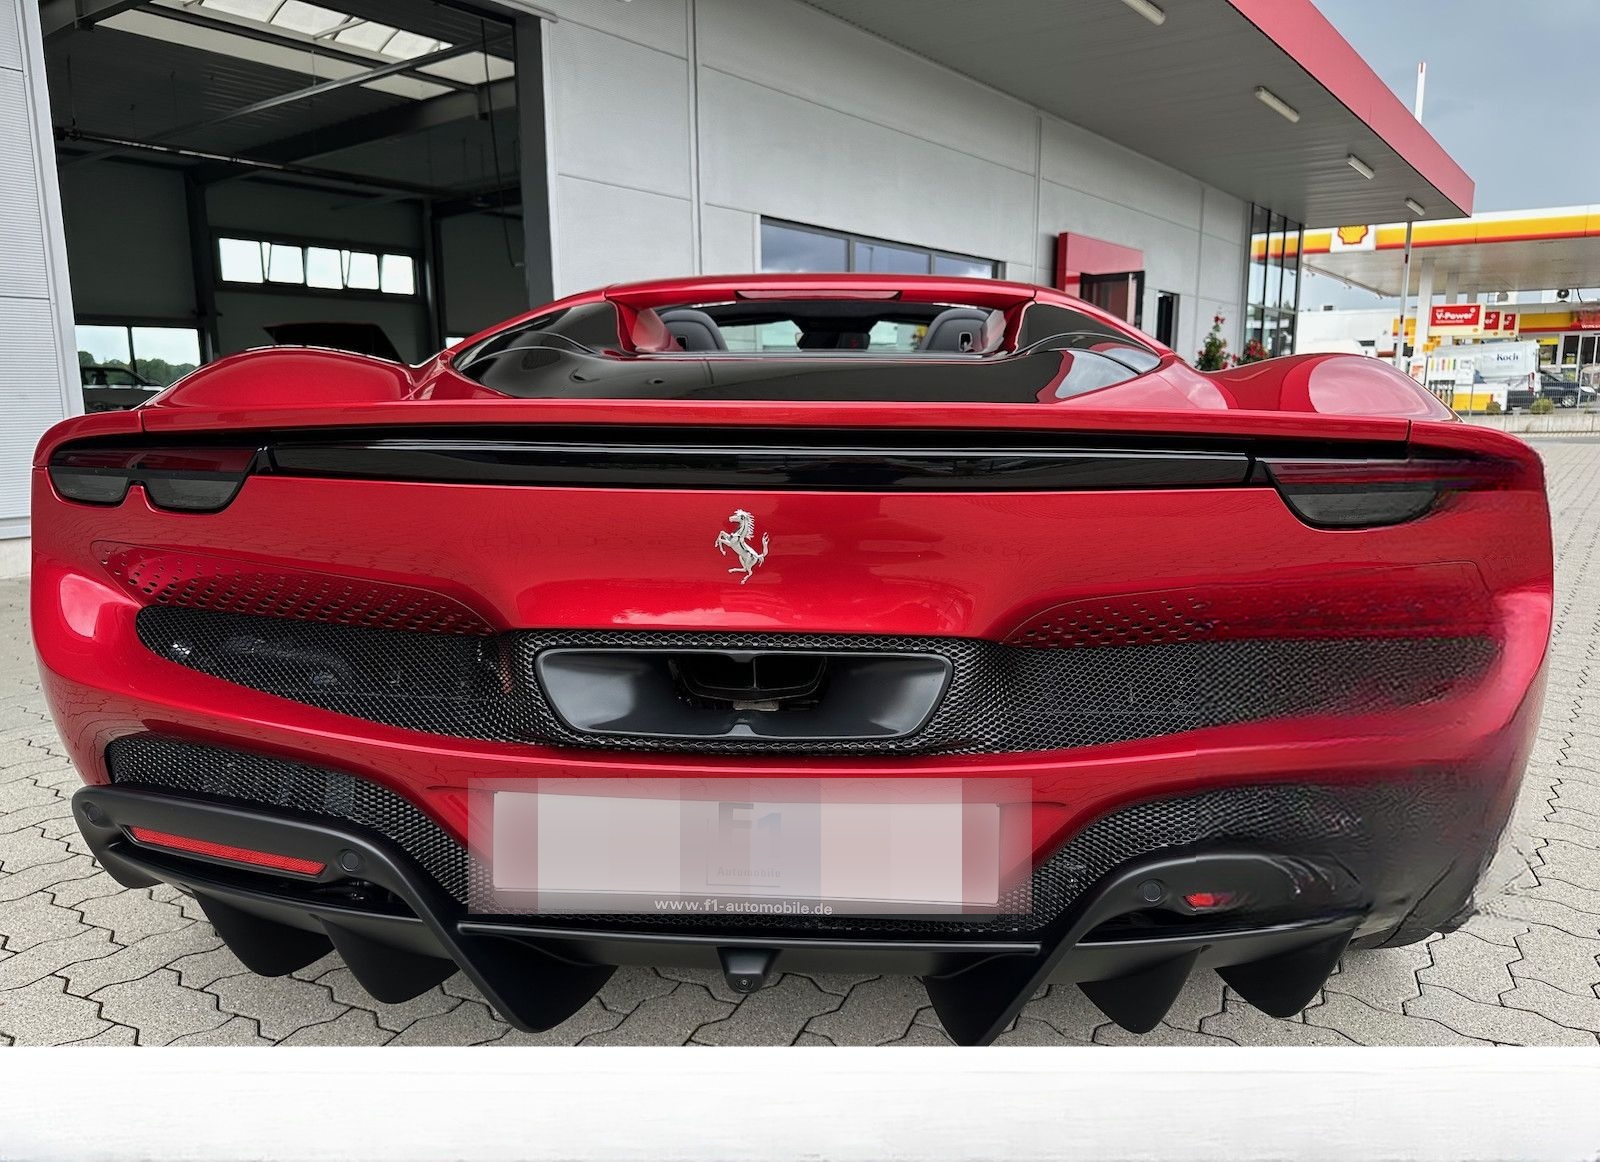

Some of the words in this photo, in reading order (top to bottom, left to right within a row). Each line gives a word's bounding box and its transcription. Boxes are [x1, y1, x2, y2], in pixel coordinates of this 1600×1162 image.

[1436, 311, 1473, 320] V-Power
[1496, 353, 1519, 361] Koch
[717, 866, 782, 879] Automobile
[654, 898, 833, 915] www.f1-automobile.de
